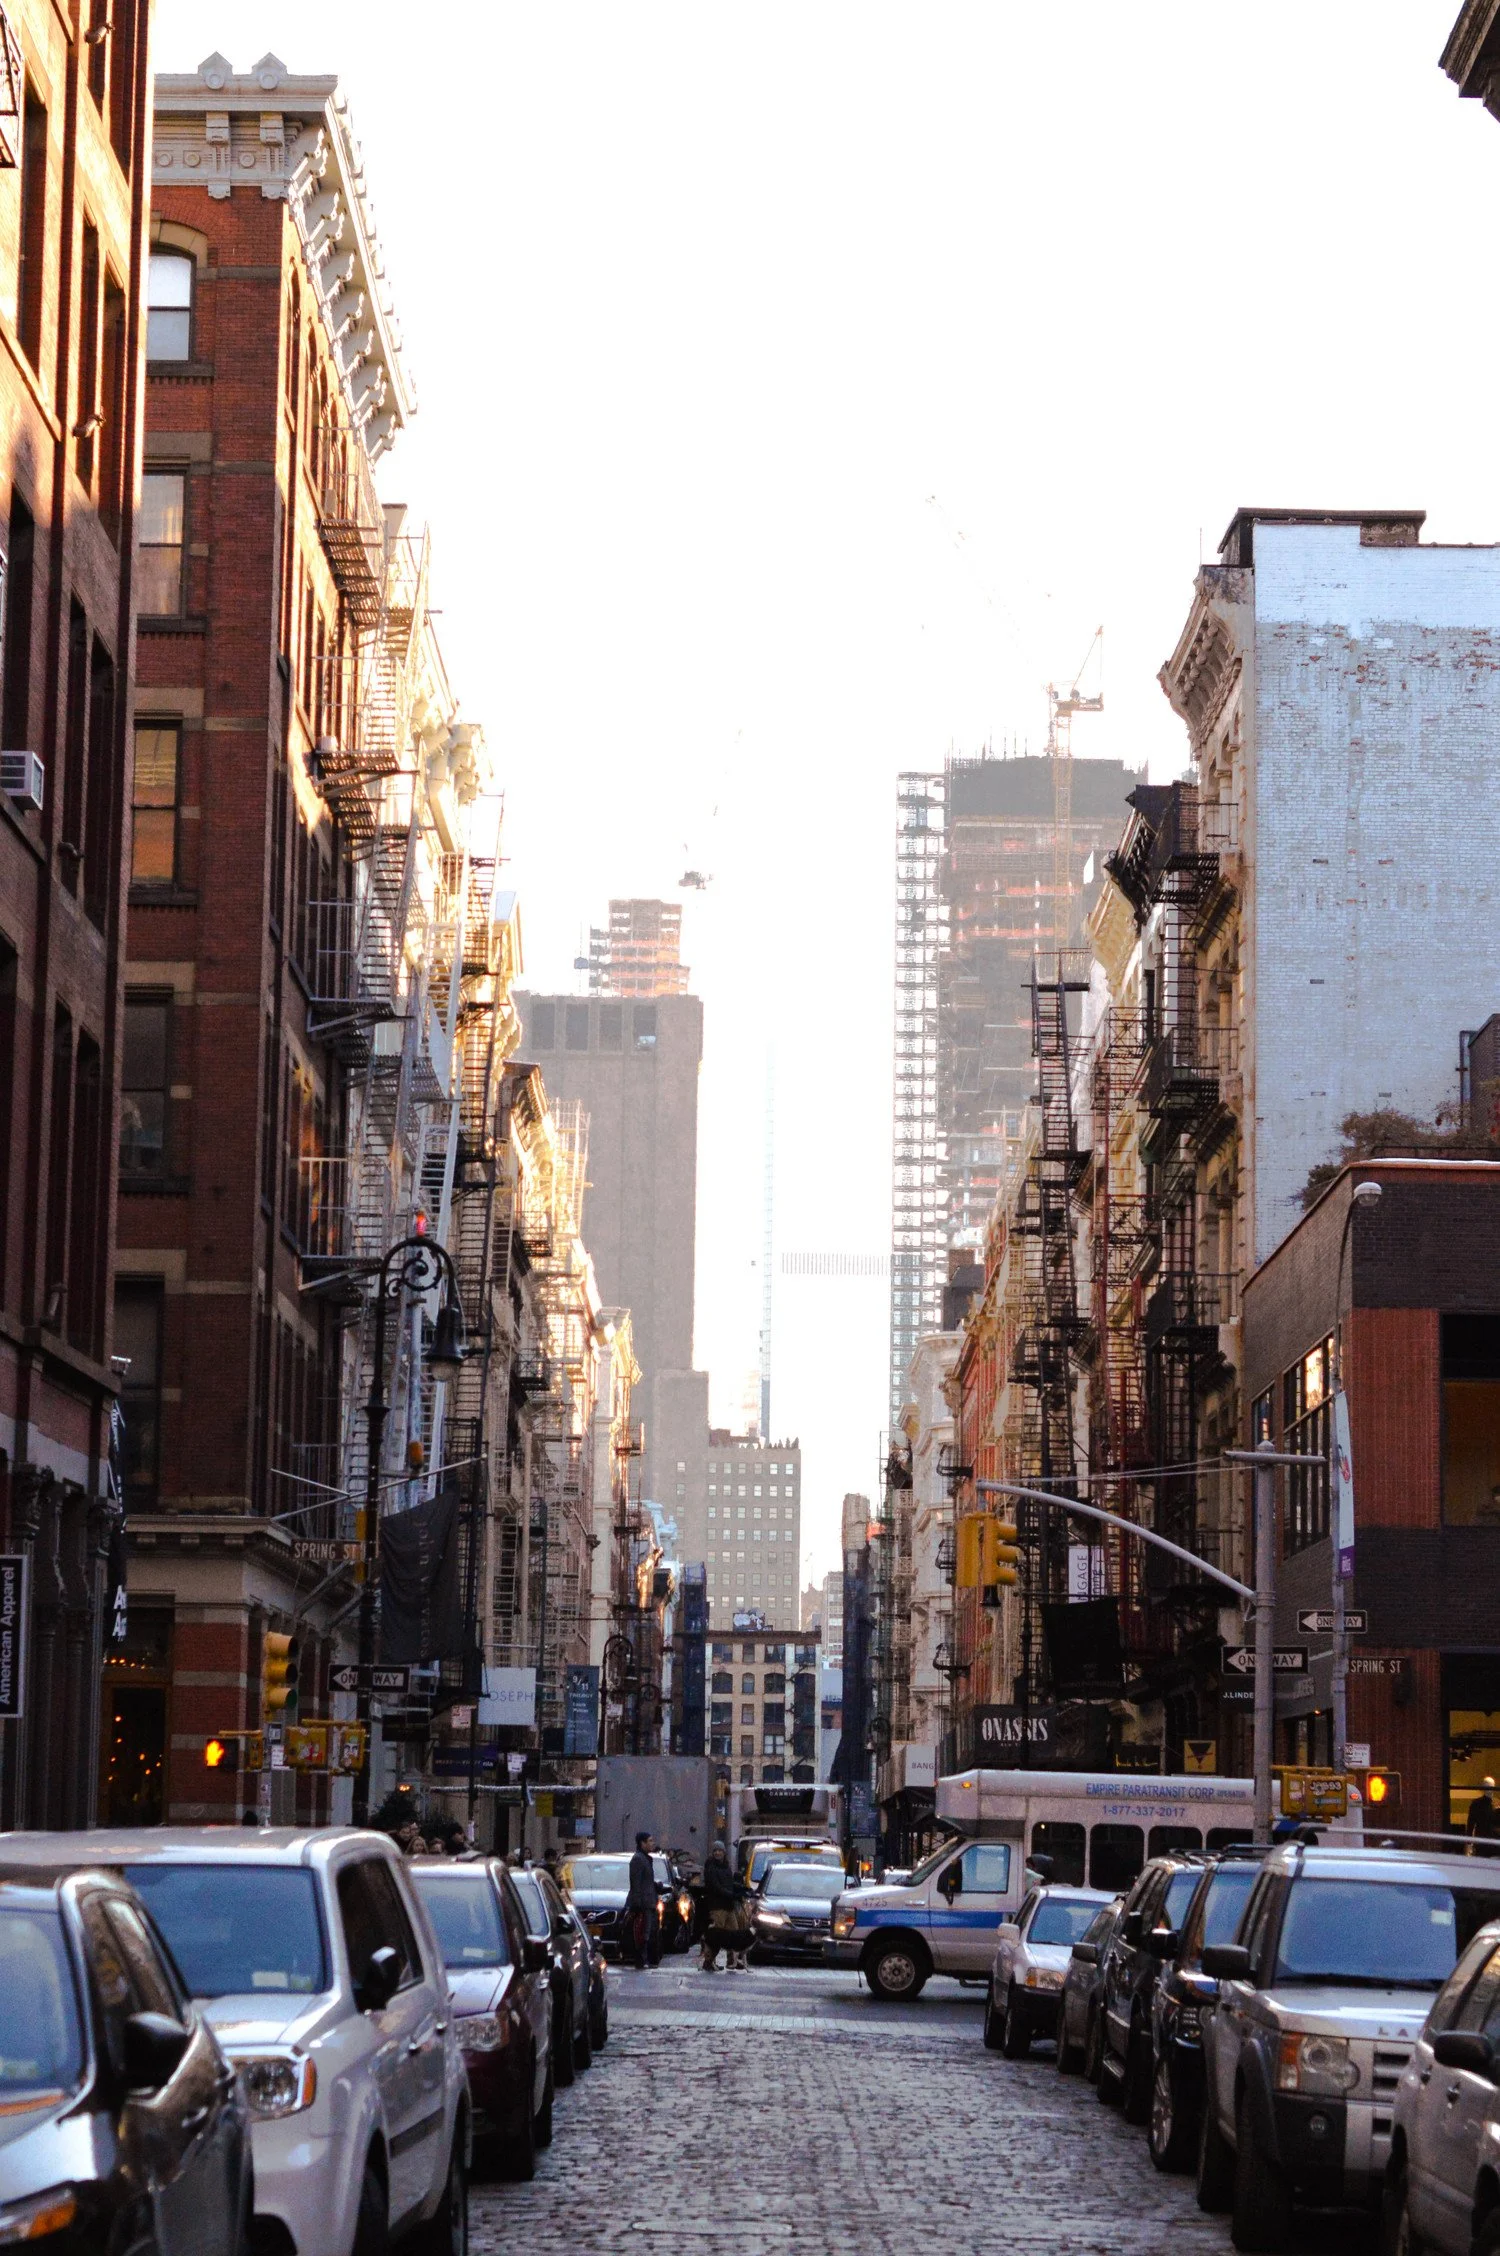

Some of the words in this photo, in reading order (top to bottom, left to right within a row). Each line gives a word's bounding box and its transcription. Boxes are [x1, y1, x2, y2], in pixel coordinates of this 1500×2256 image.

[294, 1542, 336, 1560] SPRING
[343, 1543, 358, 1561] ST
[0, 1566, 16, 1627] Apparel
[0, 1630, 12, 1706] American
[1238, 1655, 1255, 1667] ON
[1350, 1660, 1384, 1674] SPRING
[1390, 1660, 1402, 1674] ST
[340, 1672, 359, 1685] ON
[373, 1672, 400, 1685] WAY
[489, 1690, 535, 1702] OSEPH
[1086, 1783, 1120, 1797] EMPIRE
[1123, 1784, 1186, 1799] PARATRANSIT
[1188, 1786, 1215, 1799] CORP
[1102, 1805, 1186, 1818] 1-877-337-2017
